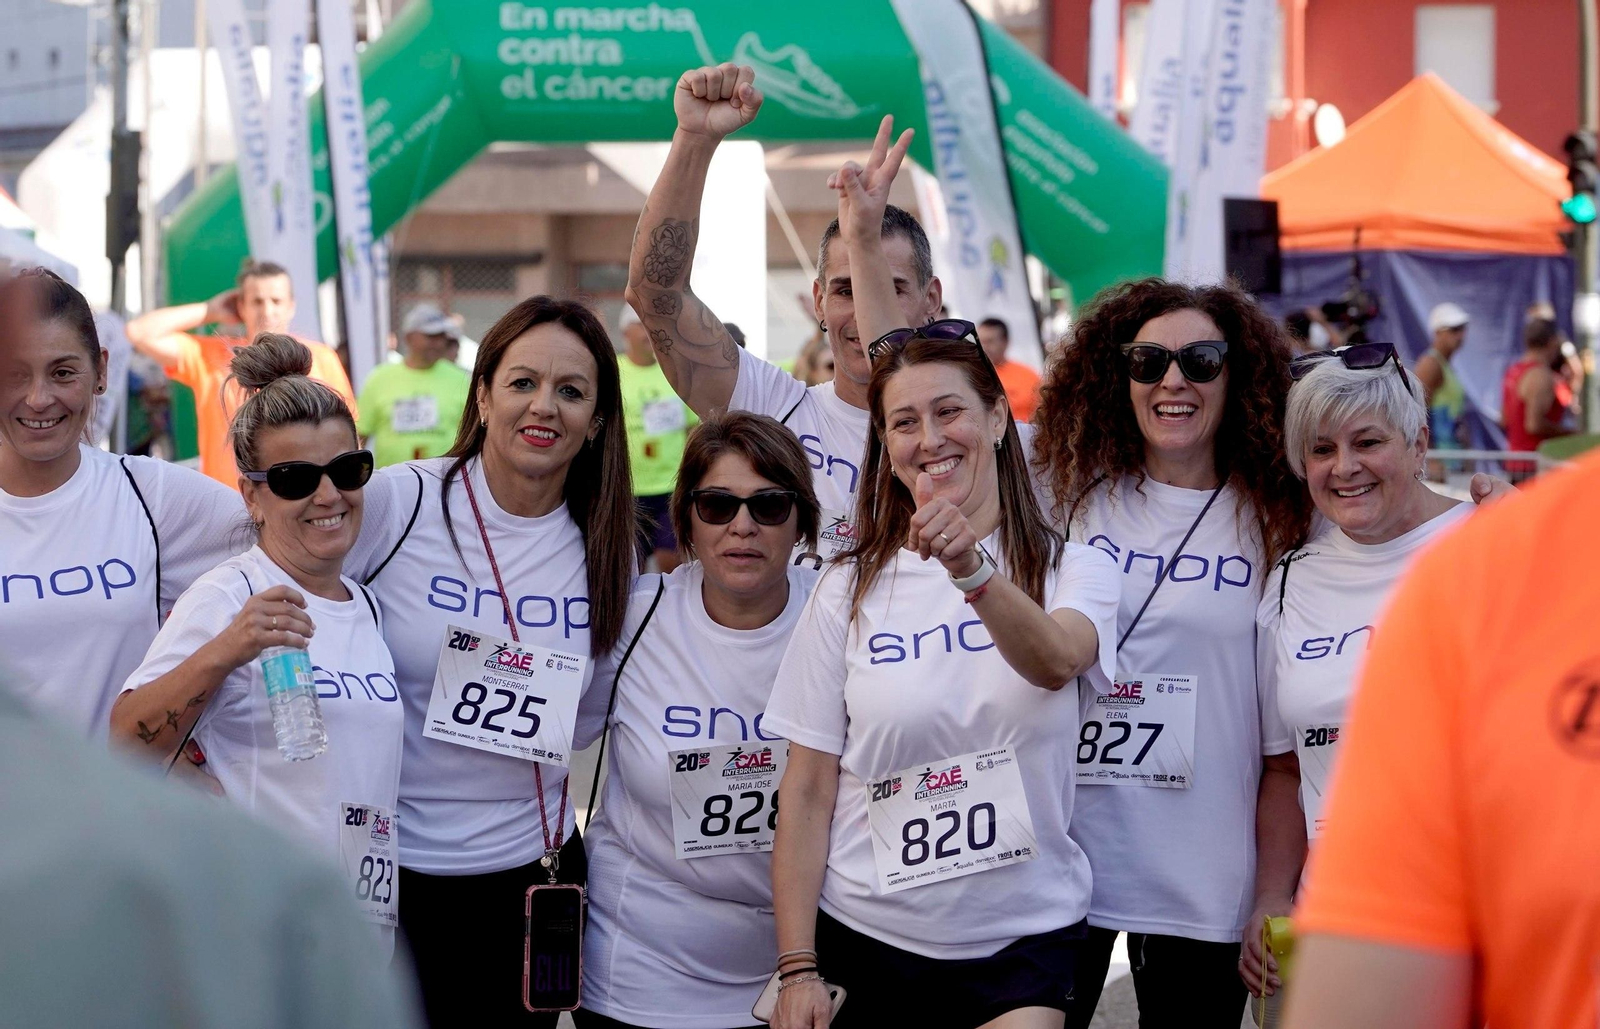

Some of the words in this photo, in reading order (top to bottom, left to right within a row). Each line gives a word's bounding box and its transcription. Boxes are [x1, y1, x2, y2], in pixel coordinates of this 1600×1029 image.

[499, 2, 548, 31] En
[554, 2, 695, 32] marcha
[498, 33, 621, 66] contra
[501, 67, 537, 99] el
[544, 67, 673, 100] cáncer
[1215, 0, 1245, 145] aqual
[799, 434, 858, 493] sn
[2, 558, 136, 603] nop
[428, 576, 591, 638] snop
[448, 631, 471, 651] 20
[869, 620, 996, 665] sno
[1296, 625, 1375, 660] sn
[485, 660, 533, 677] INTERRUNNING
[497, 650, 534, 670] CAE
[312, 666, 398, 702] sno
[482, 675, 529, 692] MONTSERRAT
[1108, 683, 1143, 698] CAE
[452, 682, 547, 738] 825
[1097, 697, 1145, 705] INTERRUNNING
[662, 705, 789, 741] sn
[1106, 711, 1128, 719] ELENA
[1076, 721, 1164, 766] 827
[1304, 728, 1328, 747] 20
[676, 753, 698, 772] 20
[724, 765, 775, 777] INTERRUNNING
[735, 752, 772, 769] CAE
[728, 781, 753, 791] MARIA
[754, 780, 772, 789] JOSE
[872, 779, 892, 802] 20
[916, 781, 967, 800] INTERRUNNING
[926, 768, 962, 791] CAE
[346, 807, 363, 826] 20
[930, 800, 957, 812] MARTA
[902, 802, 997, 866] 820
[355, 855, 393, 905] 823
